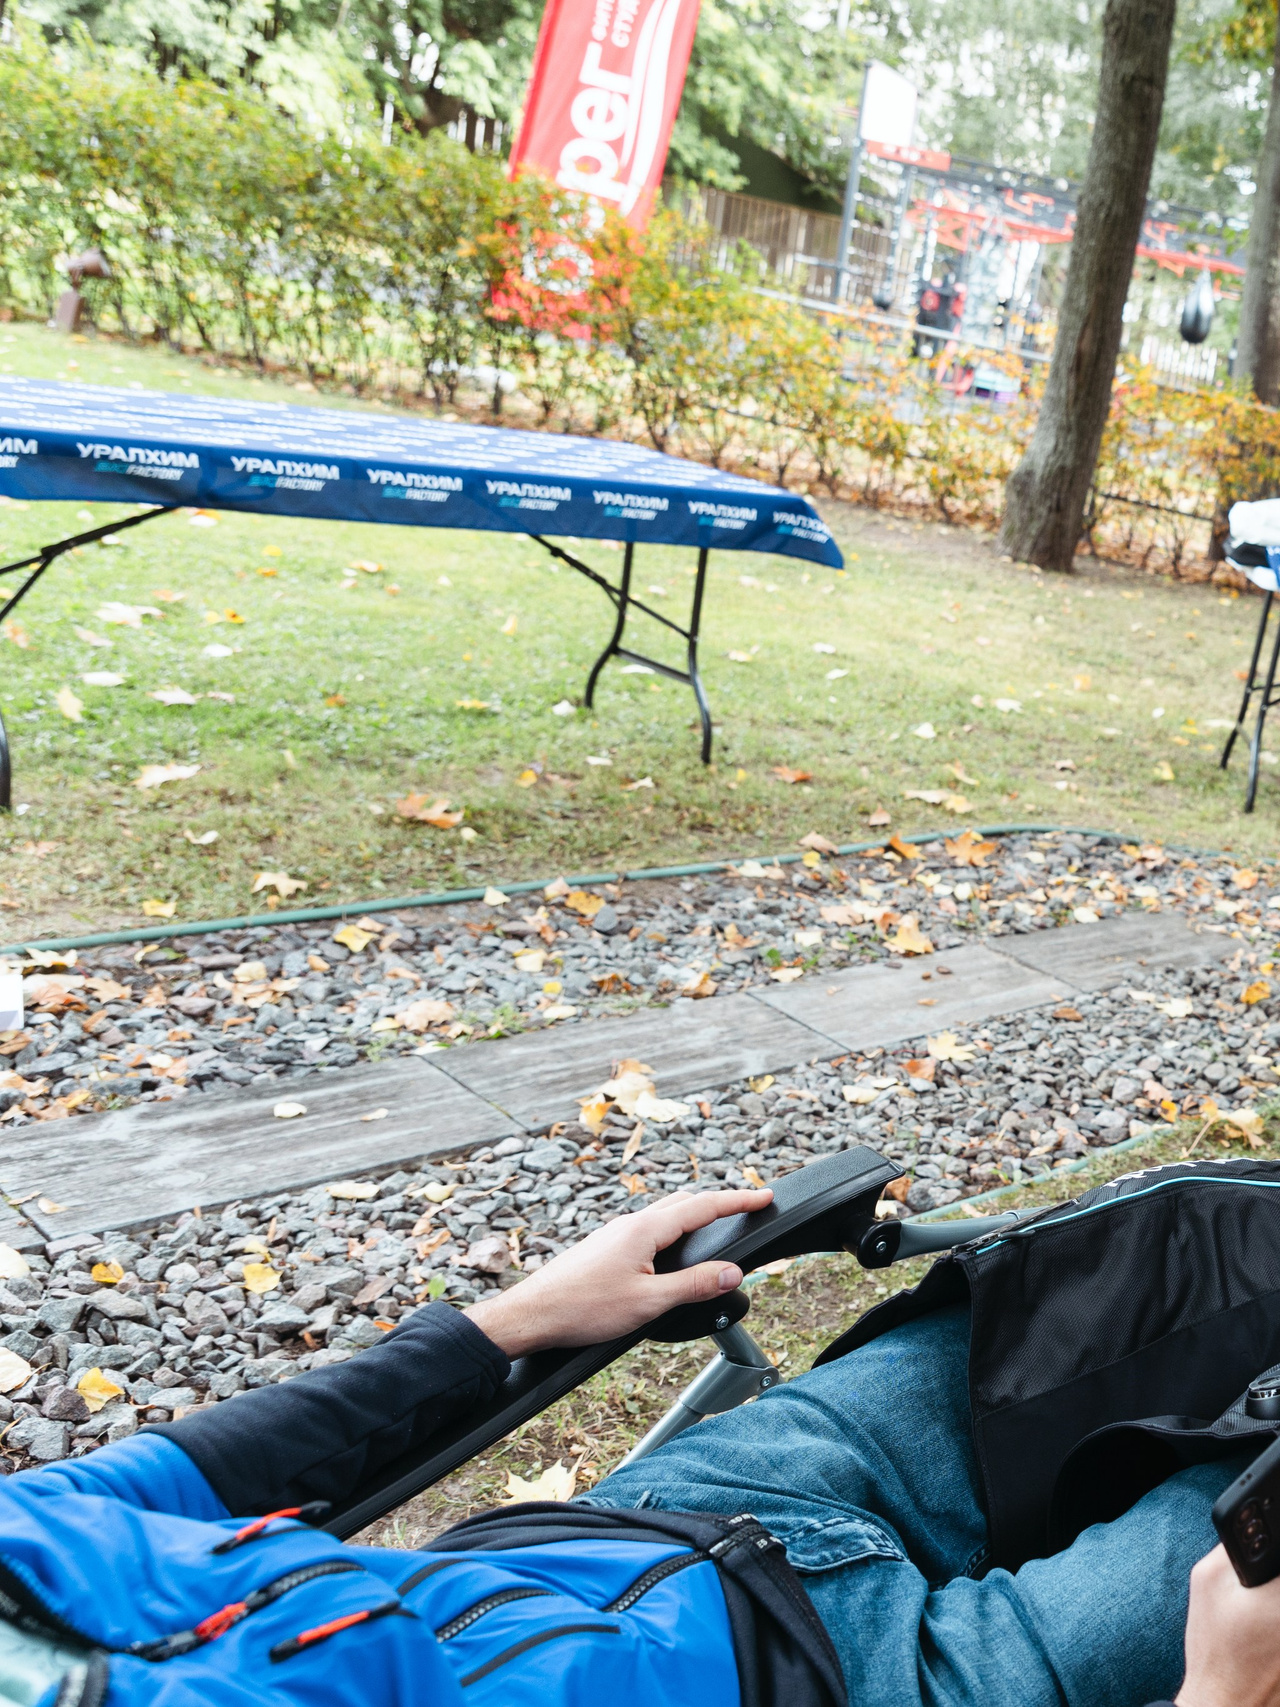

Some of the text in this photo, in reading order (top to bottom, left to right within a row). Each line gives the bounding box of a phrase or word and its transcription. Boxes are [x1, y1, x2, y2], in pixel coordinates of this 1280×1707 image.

[76, 442, 199, 468] УРАЛХИМ
[230, 456, 340, 481] УРАЛХИМ
[366, 468, 463, 492] УРАЛХИМ
[485, 480, 571, 500] УРАЛХИМ
[593, 490, 669, 511] УРАЛХИМ
